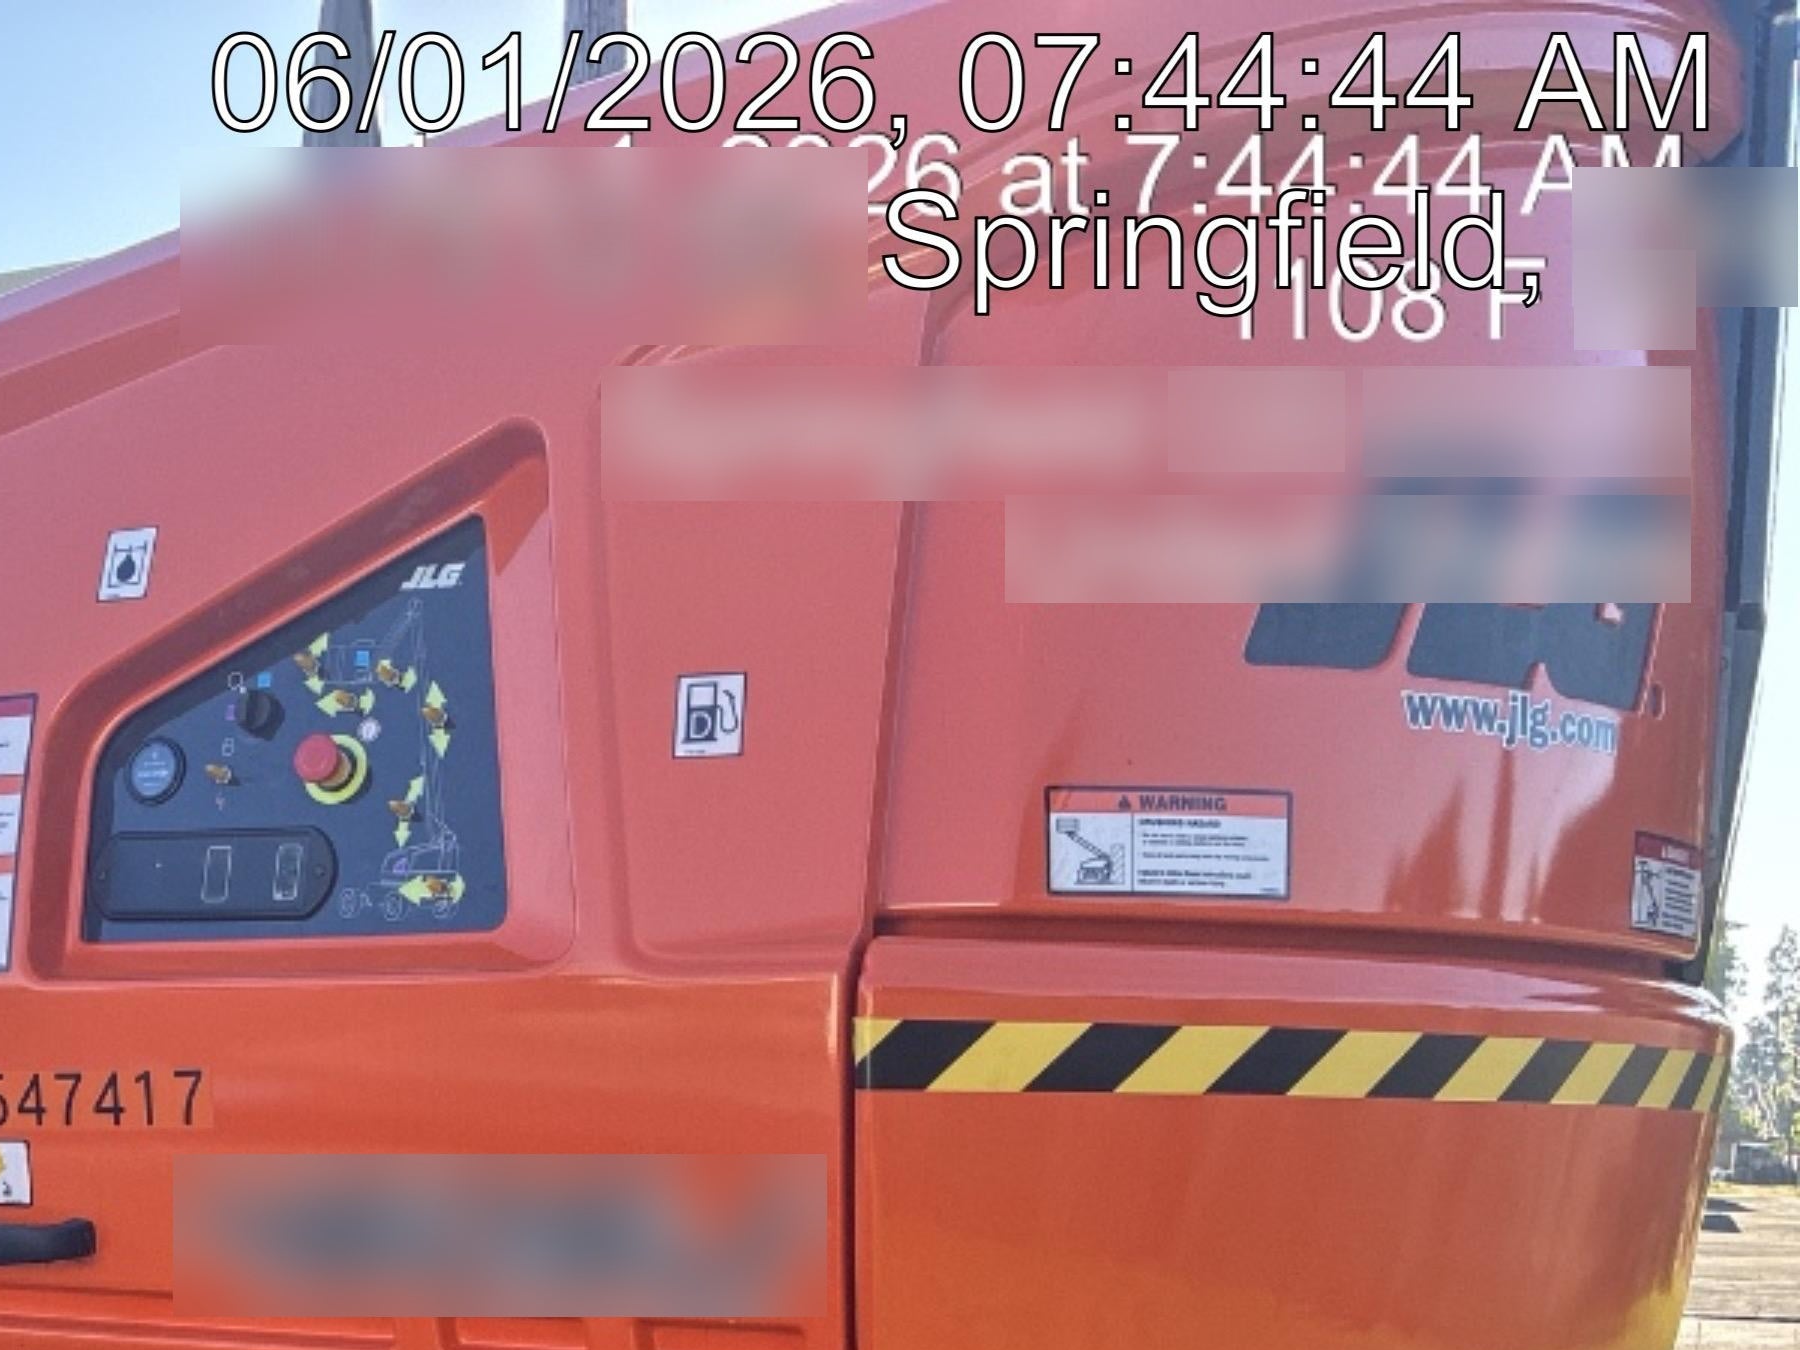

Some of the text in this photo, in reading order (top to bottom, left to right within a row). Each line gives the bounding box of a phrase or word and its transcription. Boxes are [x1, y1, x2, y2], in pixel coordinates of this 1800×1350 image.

[401, 563, 465, 589] JLG
[1402, 689, 1618, 755] www.jlg.com
[1138, 794, 1228, 812] WARNING
